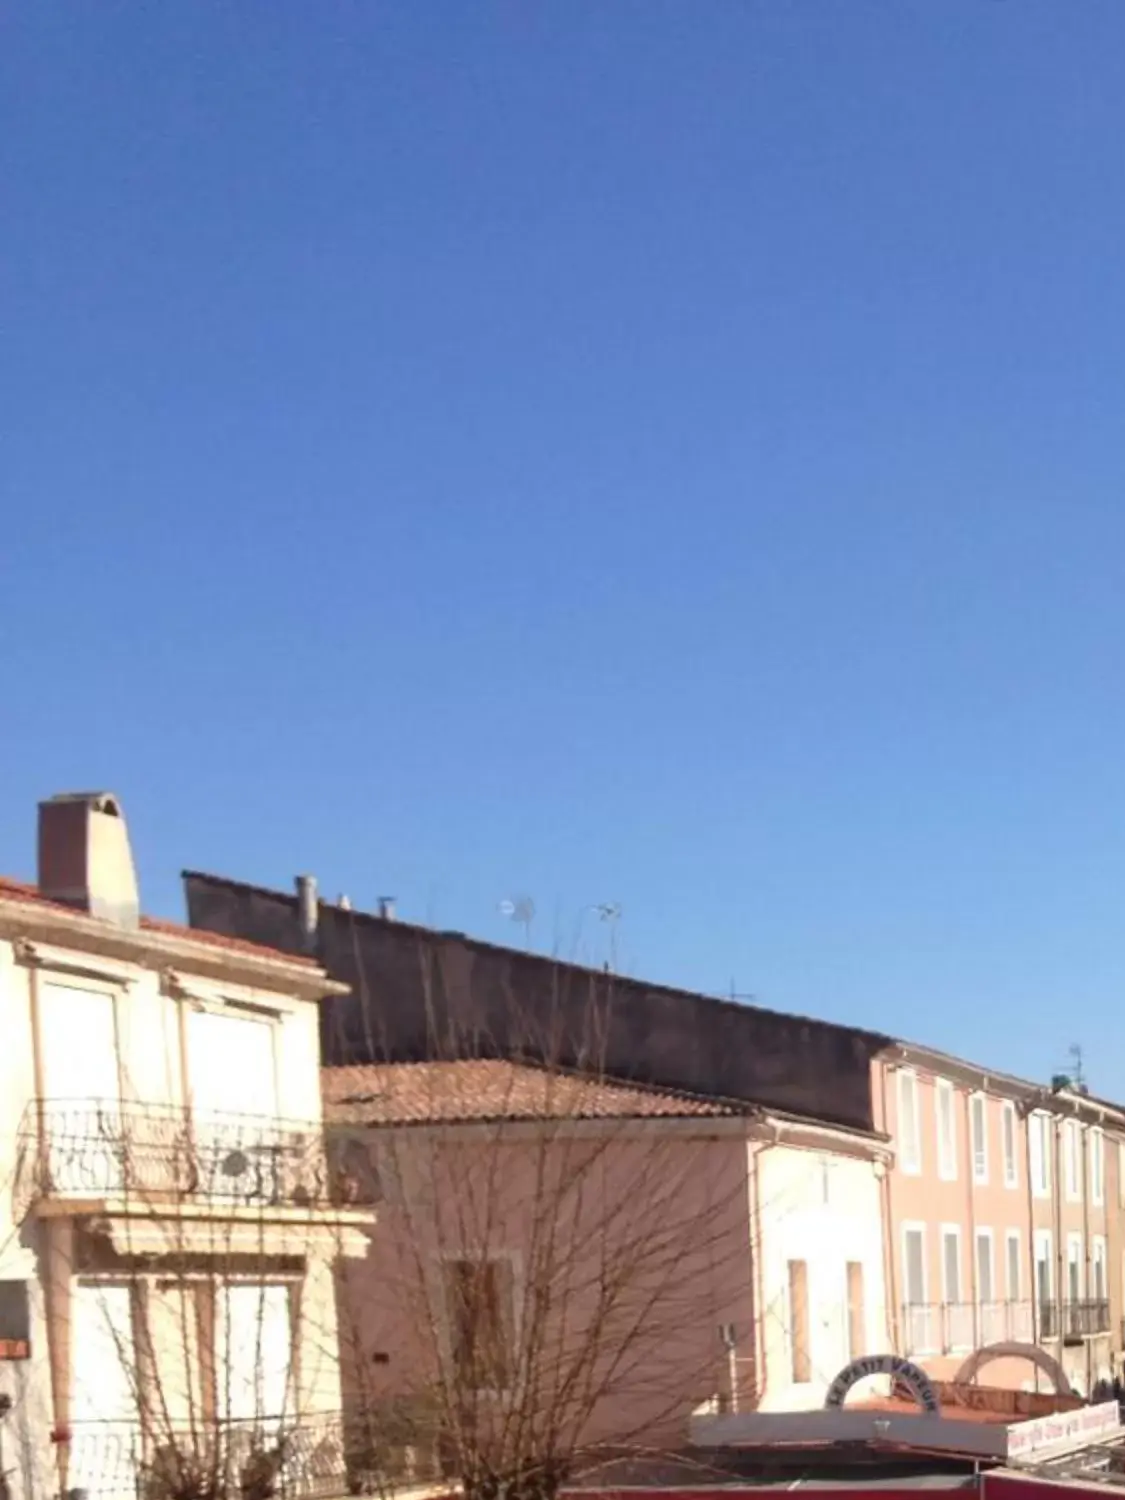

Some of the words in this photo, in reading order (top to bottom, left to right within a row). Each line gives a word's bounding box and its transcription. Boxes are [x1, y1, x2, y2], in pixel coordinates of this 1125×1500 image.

[828, 1384, 842, 1406] LE
[842, 1358, 885, 1384] PETIT
[891, 1356, 937, 1411] VAPEUR
